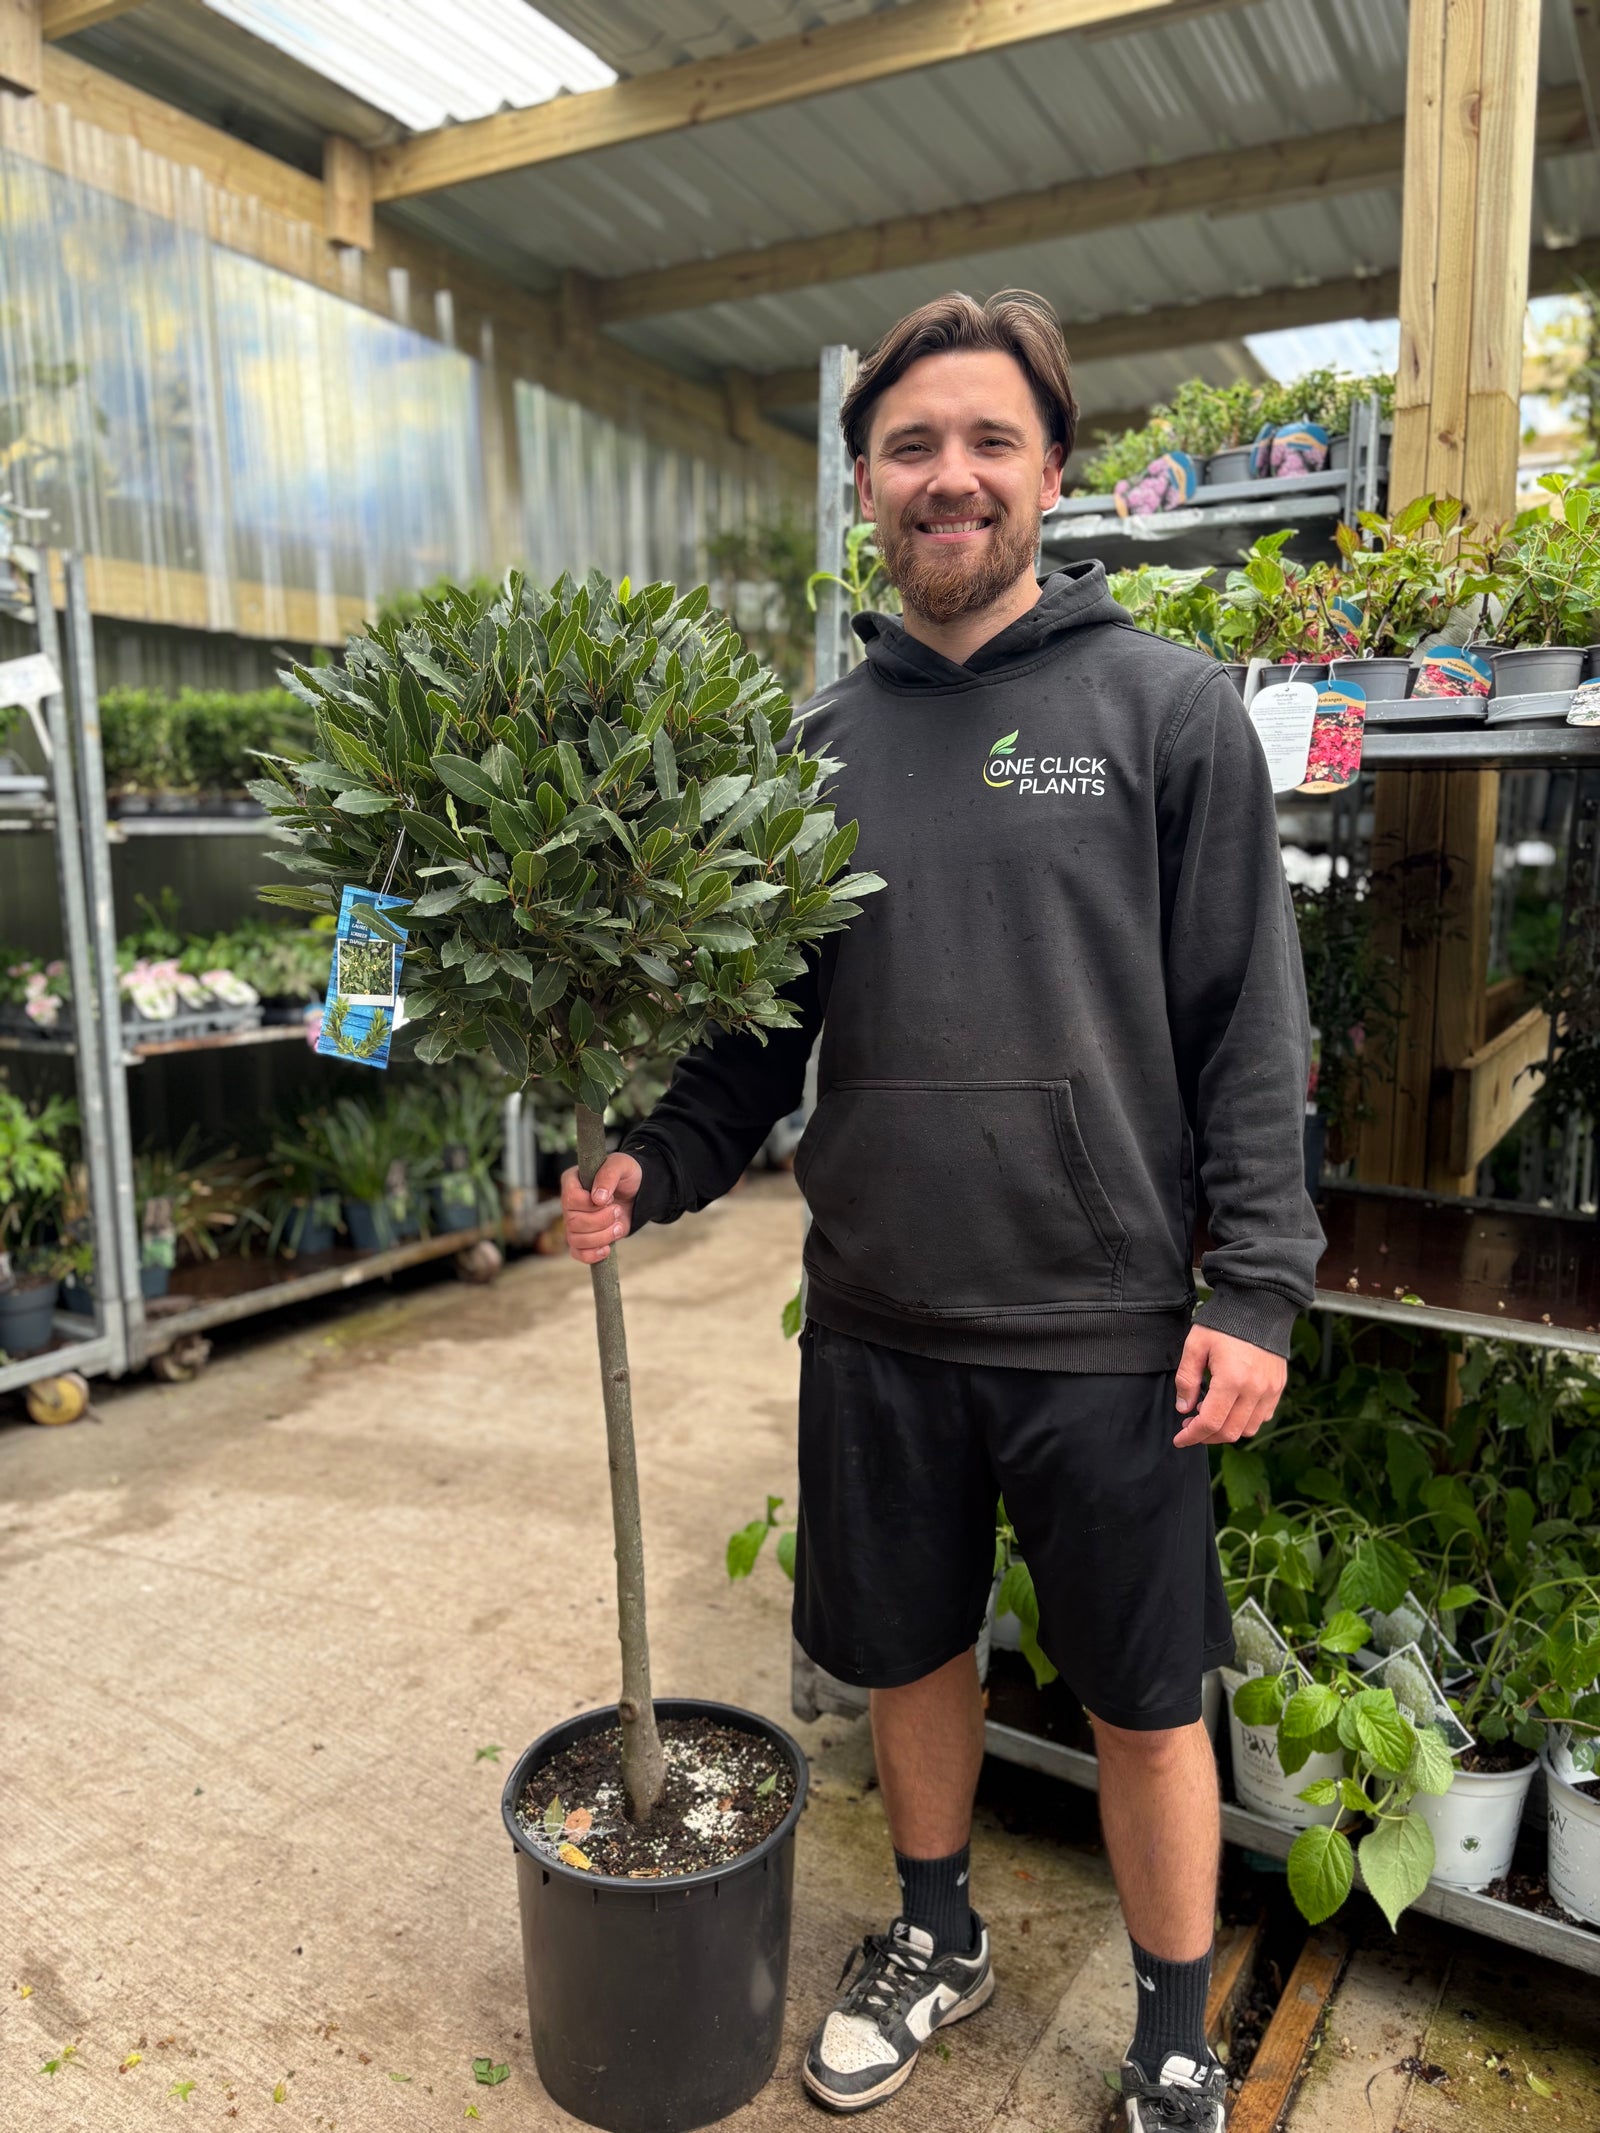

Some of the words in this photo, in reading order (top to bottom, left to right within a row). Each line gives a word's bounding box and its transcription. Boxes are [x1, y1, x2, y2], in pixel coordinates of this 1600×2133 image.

[989, 758, 1035, 776] ONE
[1040, 757, 1107, 775] CLICK
[1018, 778, 1105, 796] PLANTS
